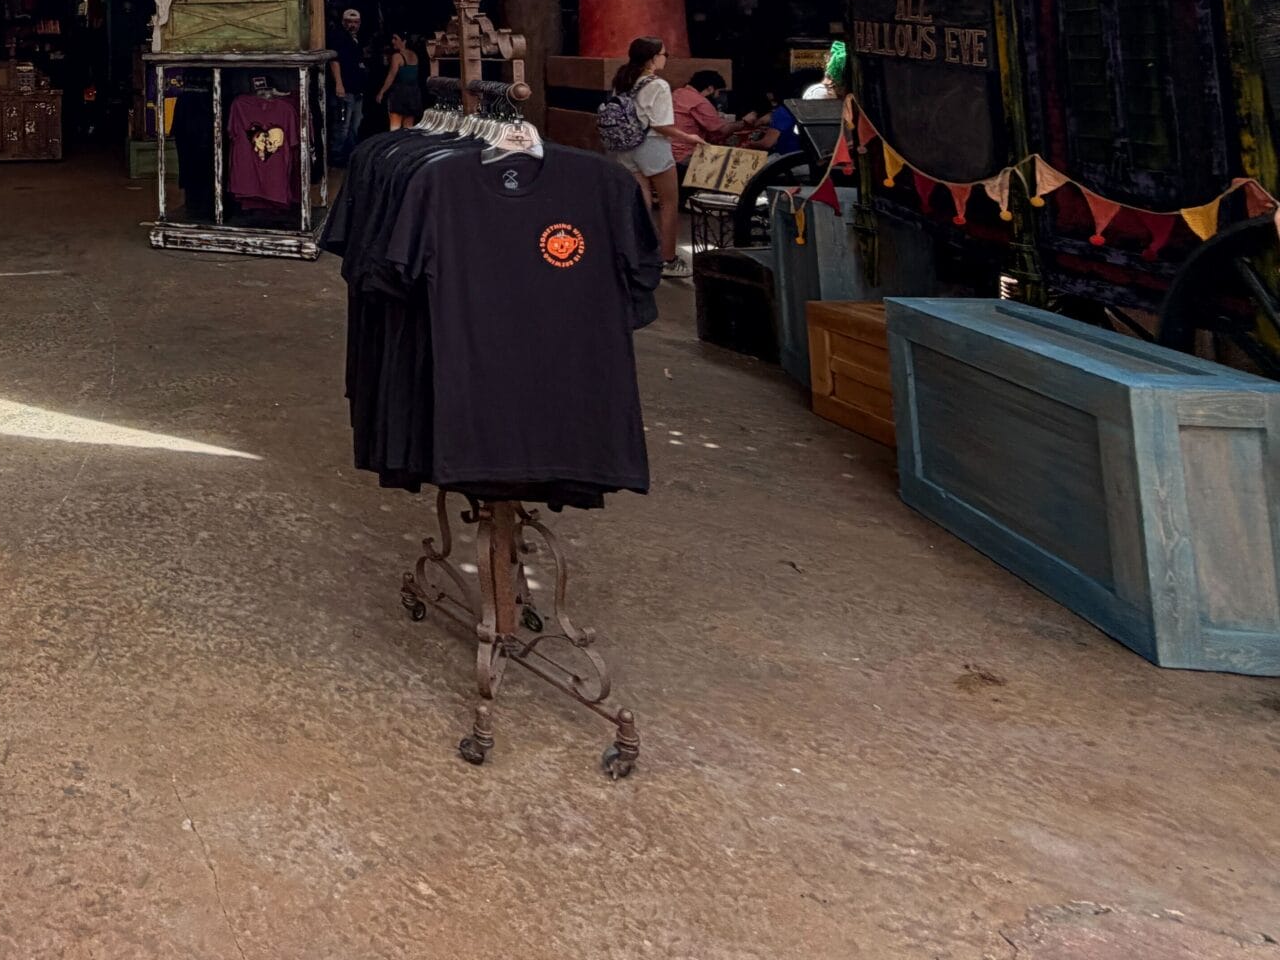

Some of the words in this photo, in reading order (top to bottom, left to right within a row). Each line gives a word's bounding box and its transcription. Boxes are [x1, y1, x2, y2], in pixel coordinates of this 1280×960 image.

[853, 20, 937, 60] HALLOWS
[944, 26, 988, 68] EYE
[539, 223, 572, 247] SOMETHING
